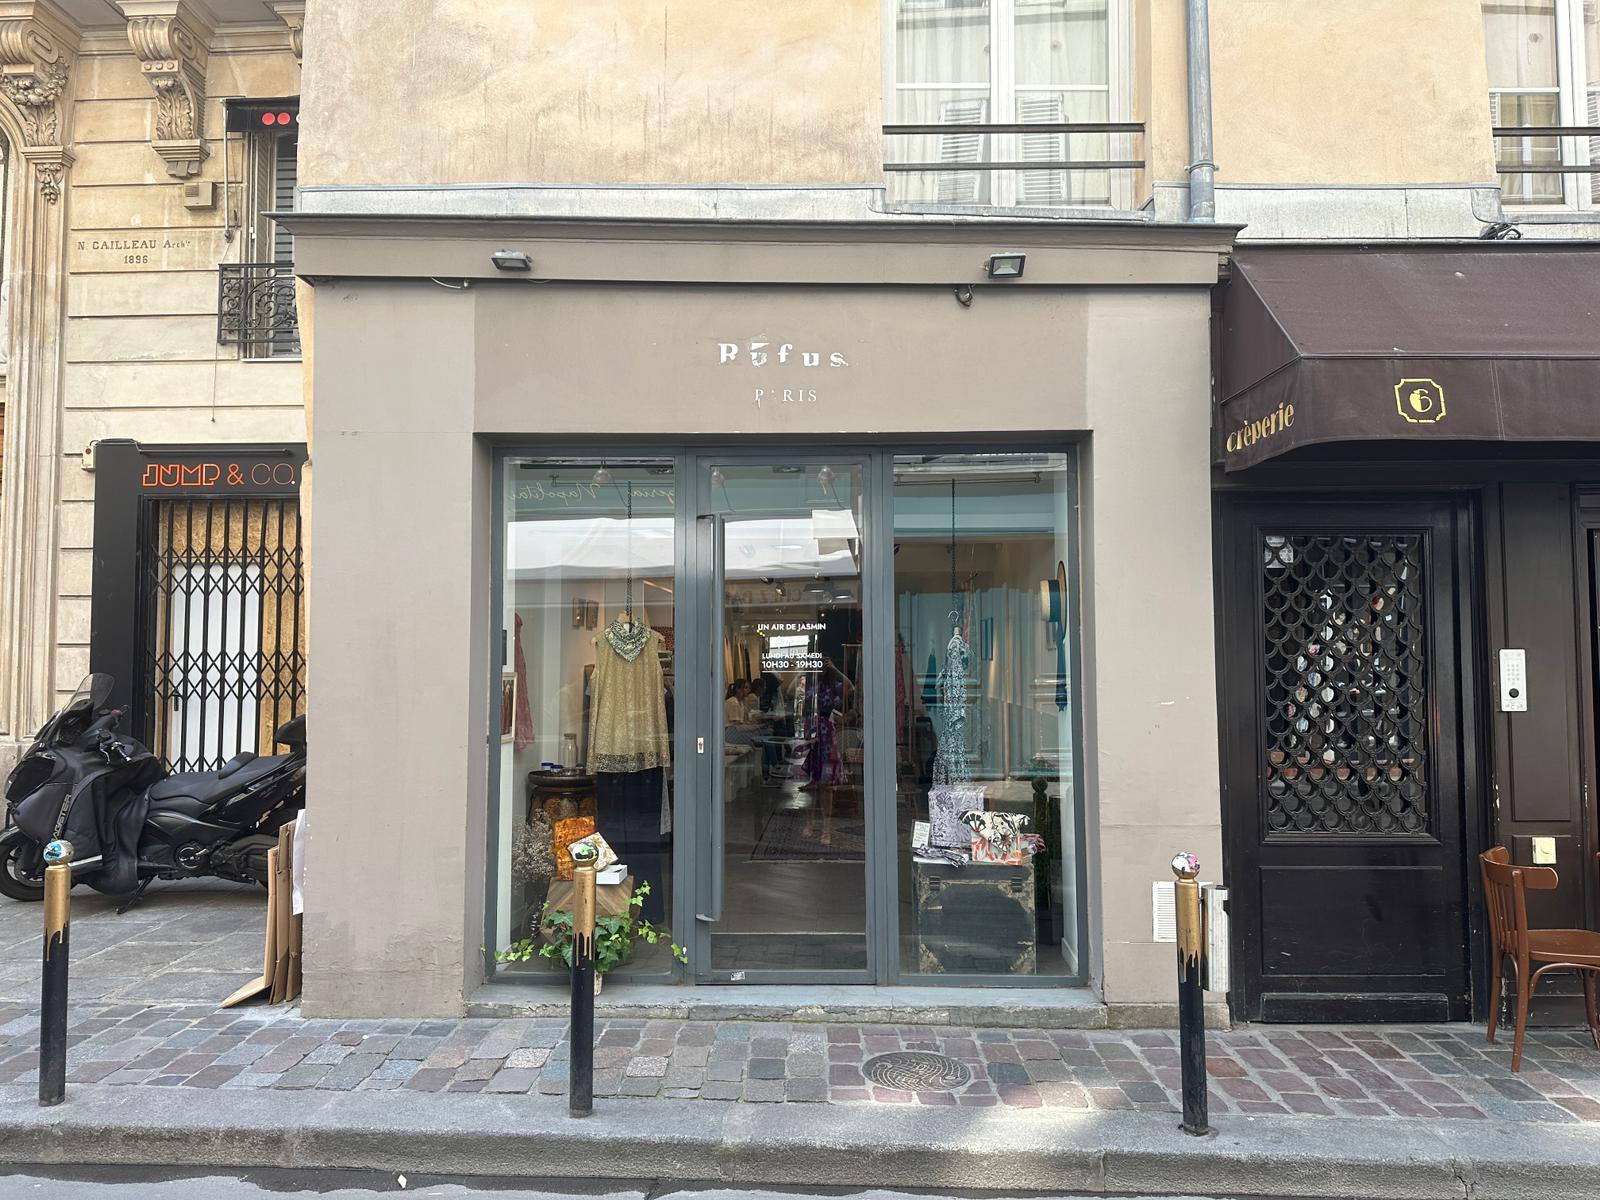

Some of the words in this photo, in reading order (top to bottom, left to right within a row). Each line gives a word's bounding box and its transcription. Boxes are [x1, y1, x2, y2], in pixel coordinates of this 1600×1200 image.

[92, 240, 157, 250] CAILLEAU
[124, 255, 149, 264] 1896
[755, 389, 817, 402] PRIS
[143, 463, 220, 487] JUMP
[227, 463, 244, 486] &
[757, 623, 769, 631] UN
[771, 623, 784, 631] AIR
[786, 623, 796, 631] DE
[797, 623, 826, 632] JASMIN
[762, 660, 789, 669] 10H30
[796, 660, 823, 669] 19H30
[51, 794, 71, 841] AGSTER
